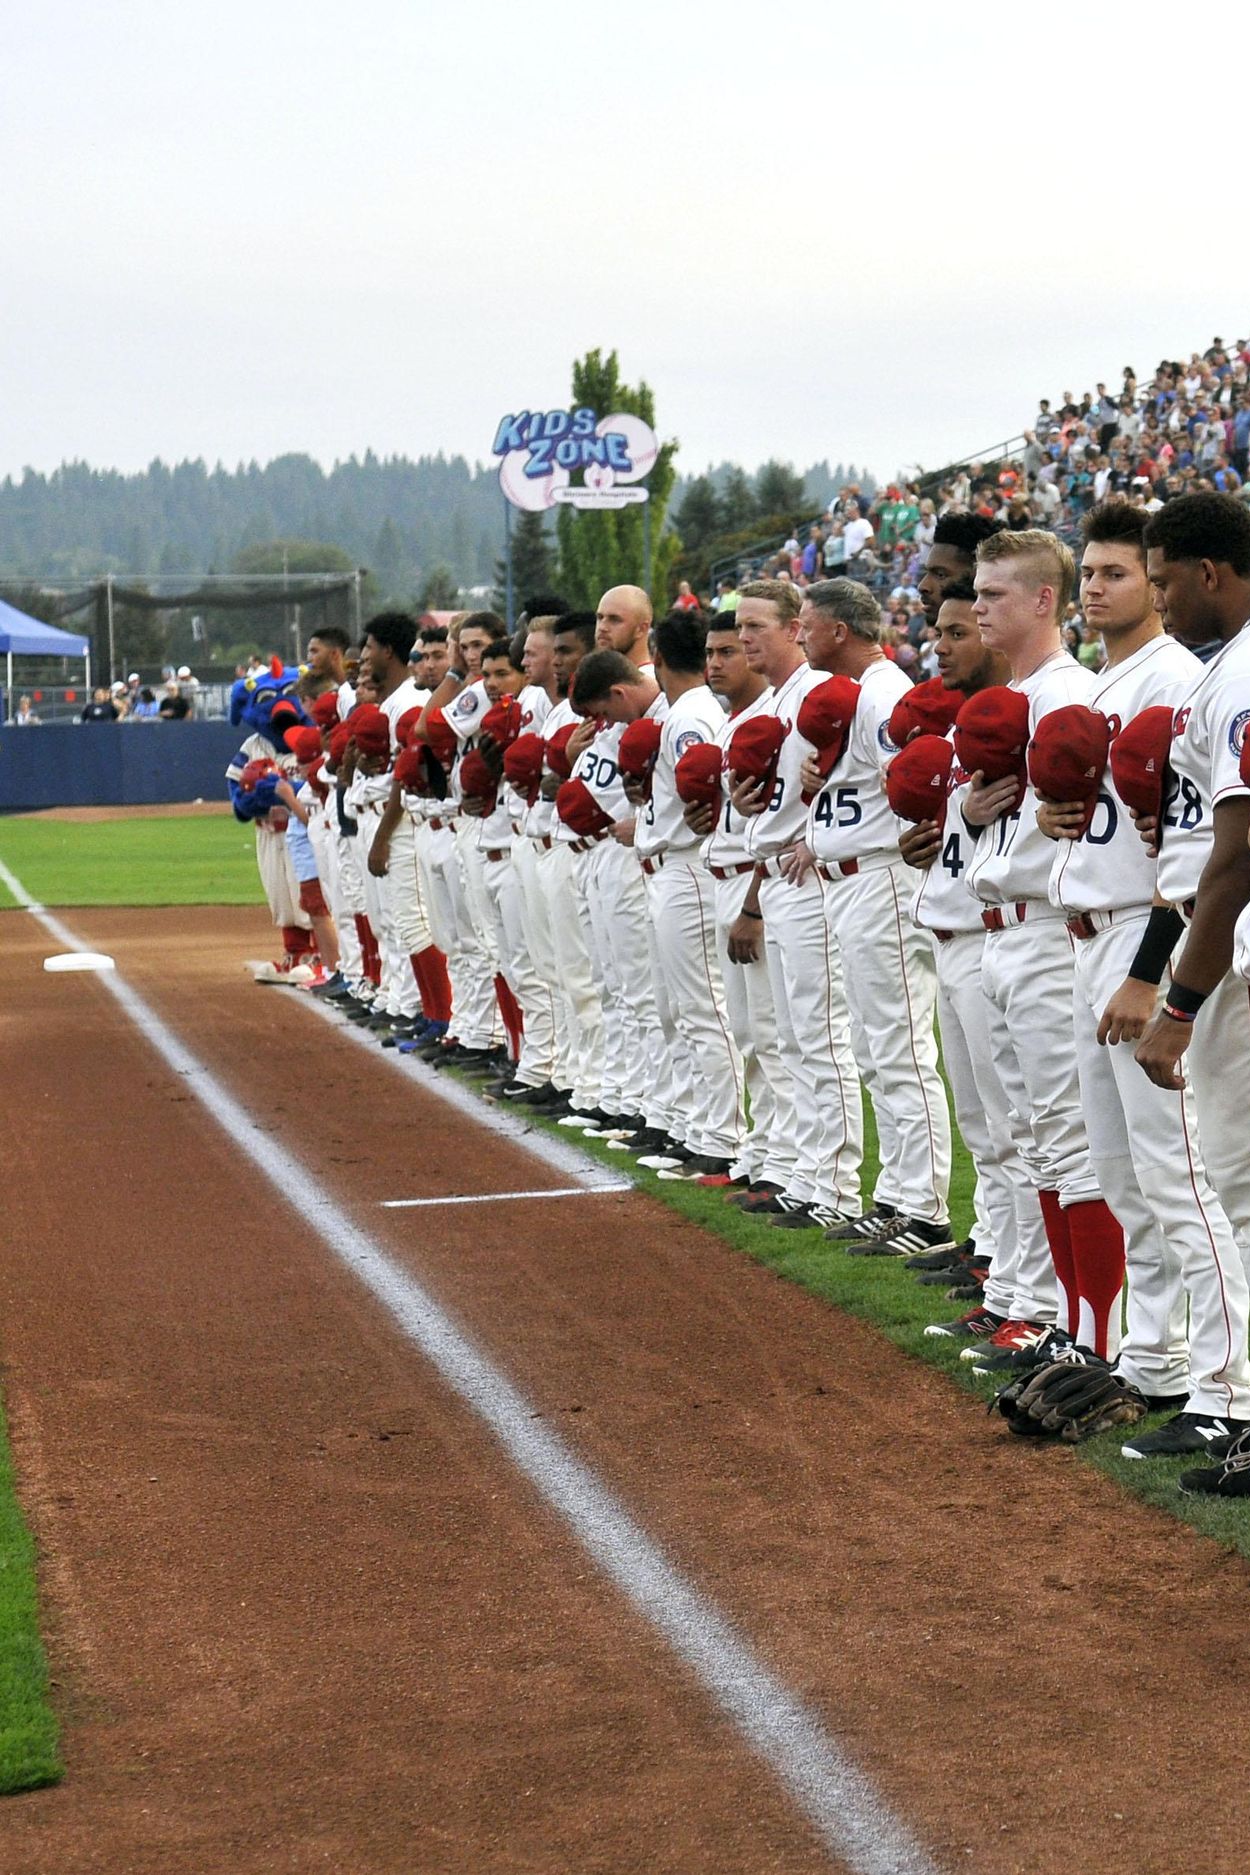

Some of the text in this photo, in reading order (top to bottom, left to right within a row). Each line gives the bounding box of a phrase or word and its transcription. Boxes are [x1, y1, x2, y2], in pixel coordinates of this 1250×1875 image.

[523, 433, 632, 480] ZONE
[579, 752, 617, 788] 30
[814, 788, 863, 828] 45
[942, 832, 964, 878] 4
